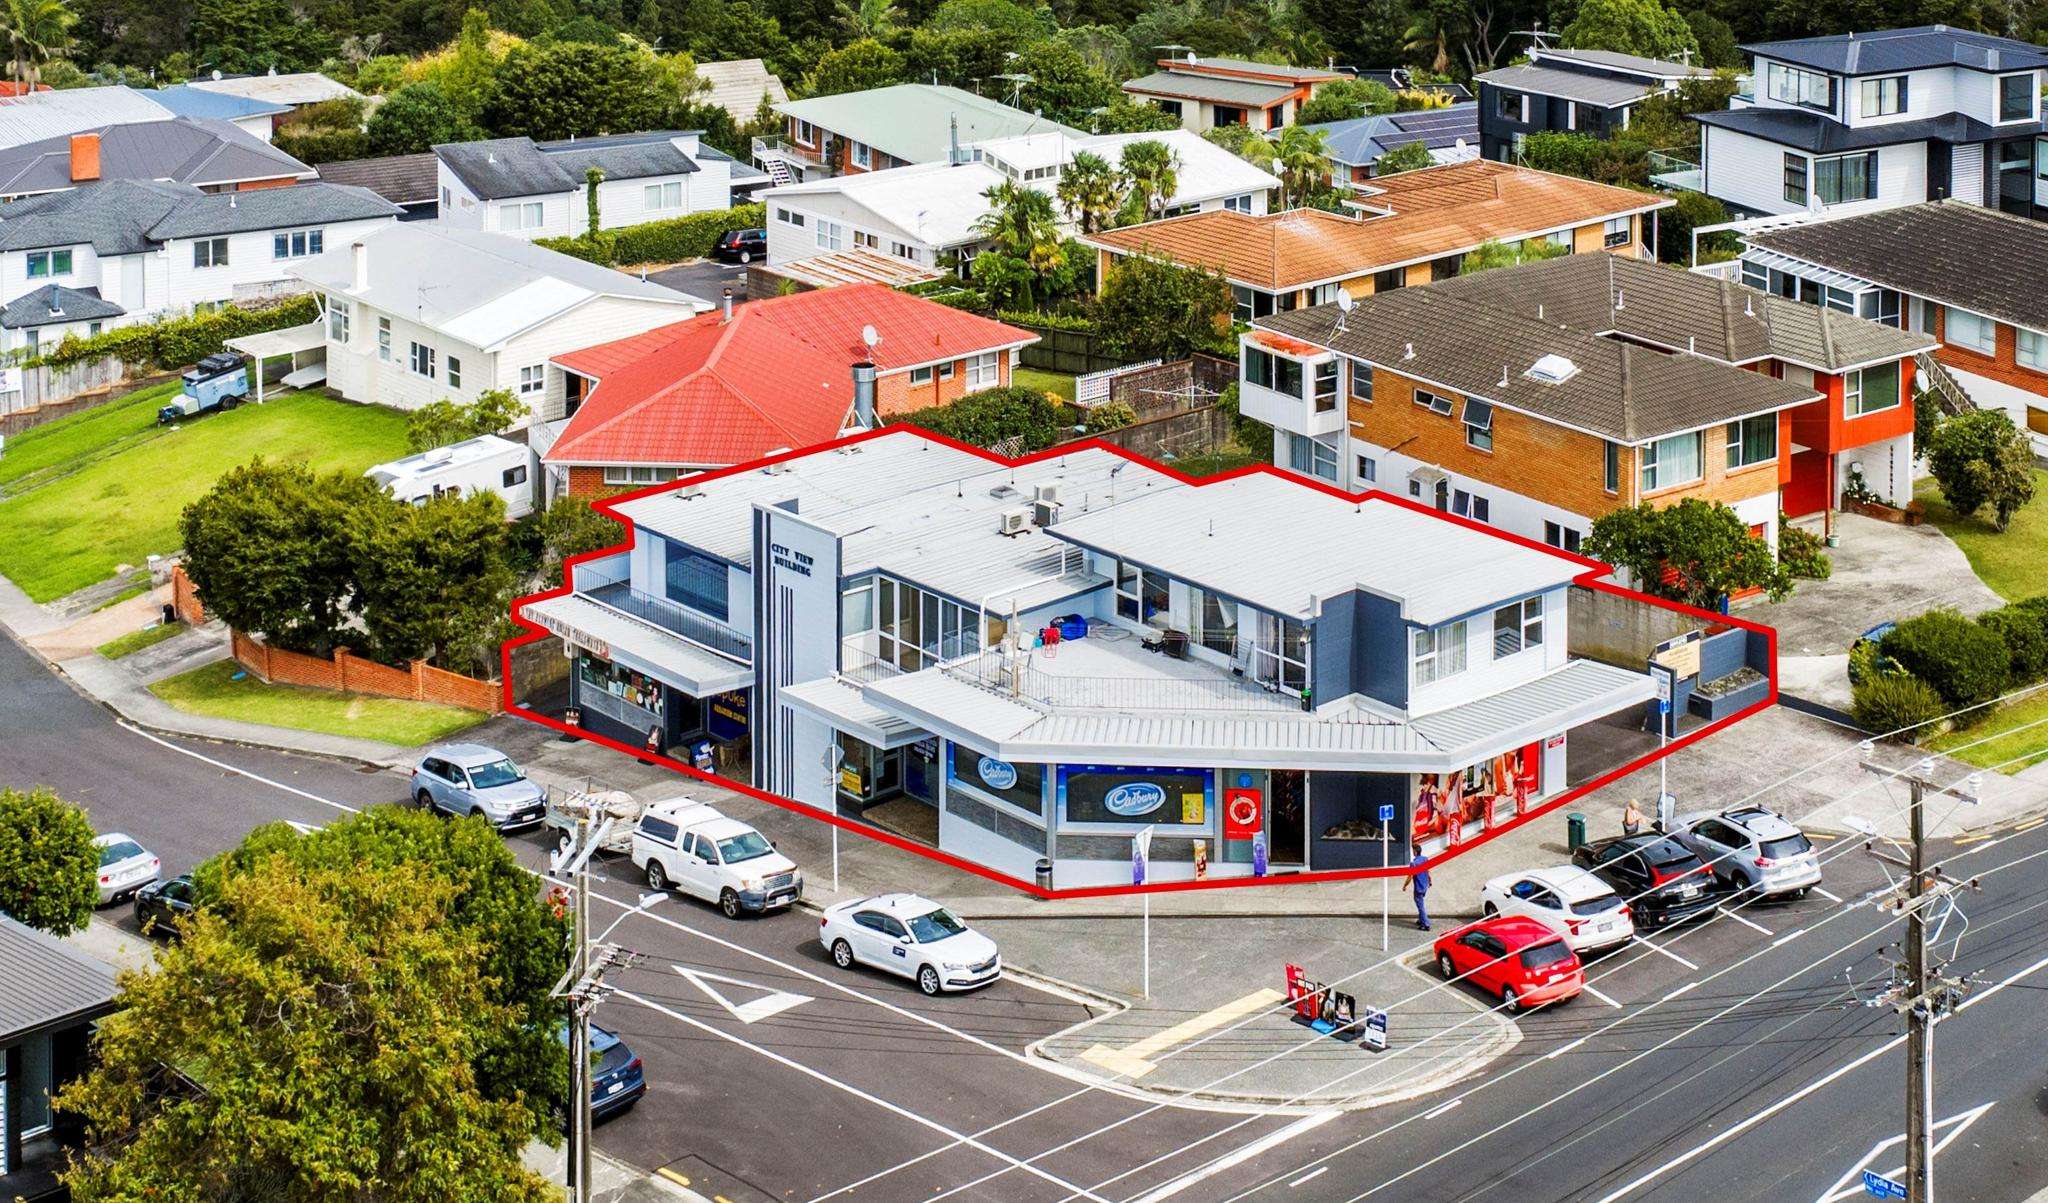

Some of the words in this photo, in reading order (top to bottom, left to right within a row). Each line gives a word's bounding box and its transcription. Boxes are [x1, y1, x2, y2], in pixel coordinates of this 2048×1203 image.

[771, 543, 790, 556] CITY
[794, 551, 814, 566] VIEW
[774, 555, 811, 577] BUILDING
[1109, 788, 1160, 810] Cadbury
[1869, 1173, 1889, 1190] Lydia
[1890, 1183, 1905, 1197] Ave
